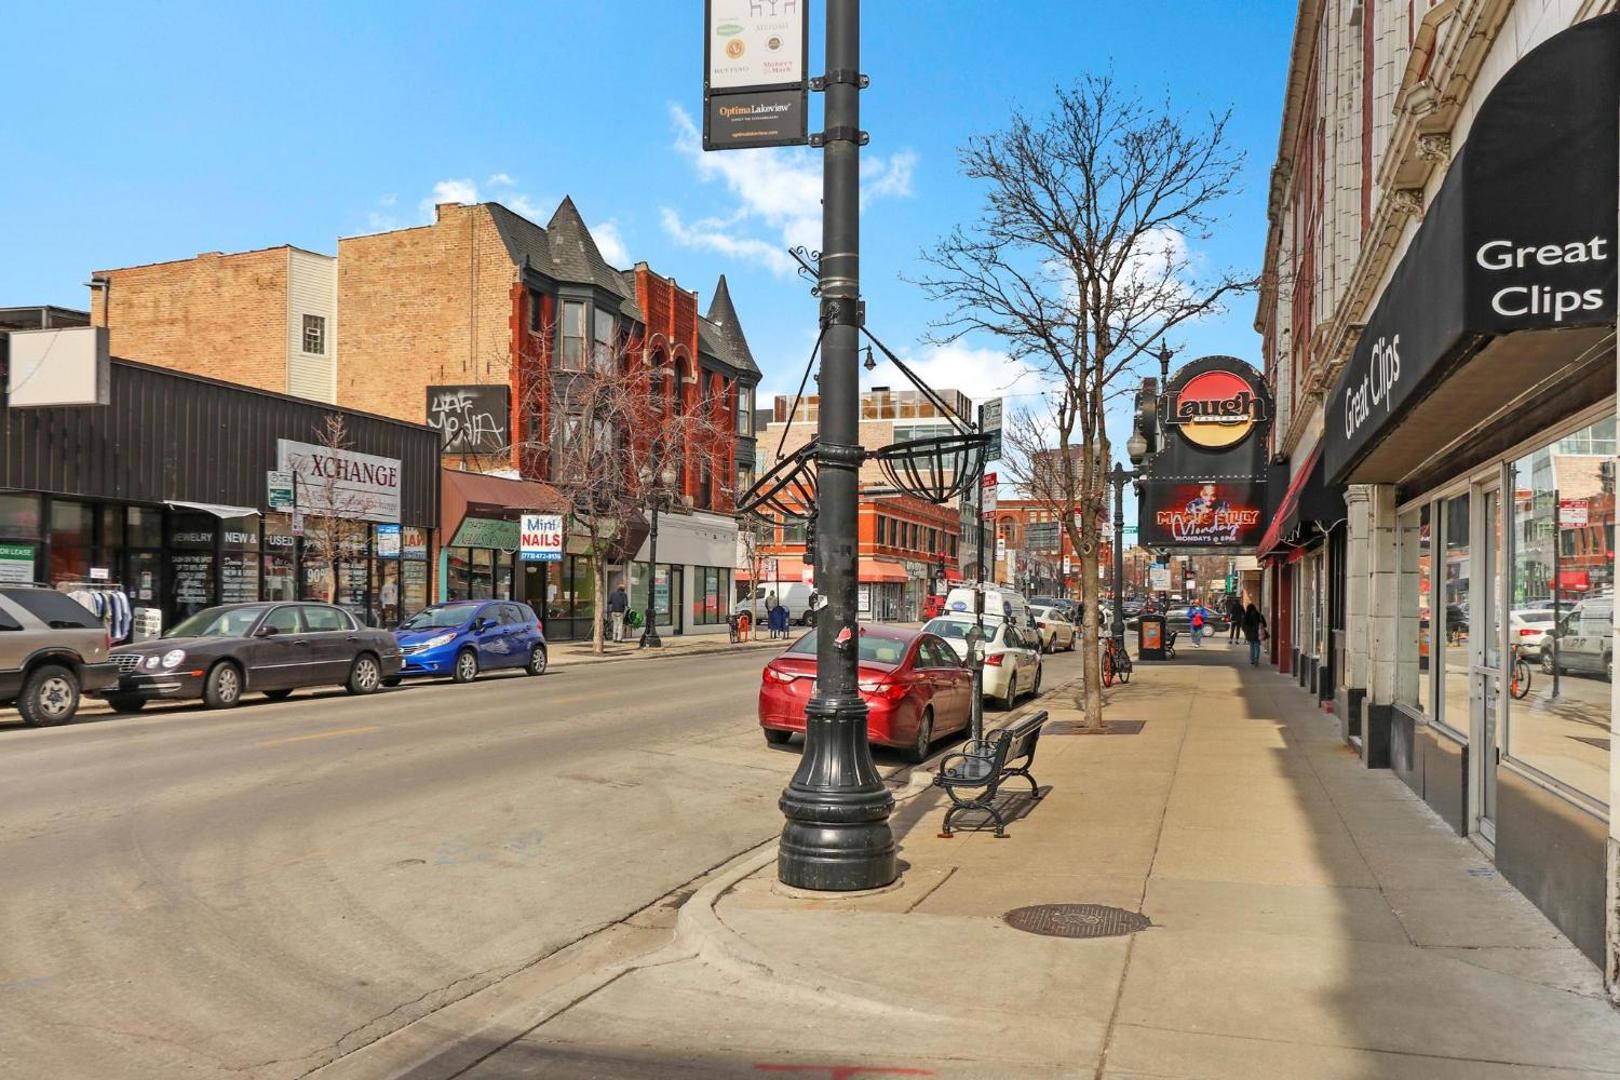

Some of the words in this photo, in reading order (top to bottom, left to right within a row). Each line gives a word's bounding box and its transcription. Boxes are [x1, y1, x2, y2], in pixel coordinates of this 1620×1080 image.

[1476, 236, 1608, 271] Great
[1492, 285, 1604, 322] Clips
[1370, 333, 1401, 412] Clips
[1164, 390, 1268, 425] Laugh
[1344, 373, 1370, 440] Great
[311, 453, 398, 489] XCHANGE
[225, 532, 248, 543] NEW
[249, 534, 257, 544] &
[269, 536, 294, 547] USED
[522, 533, 561, 547] NAILS
[1175, 535, 1212, 543] MONDAYS
